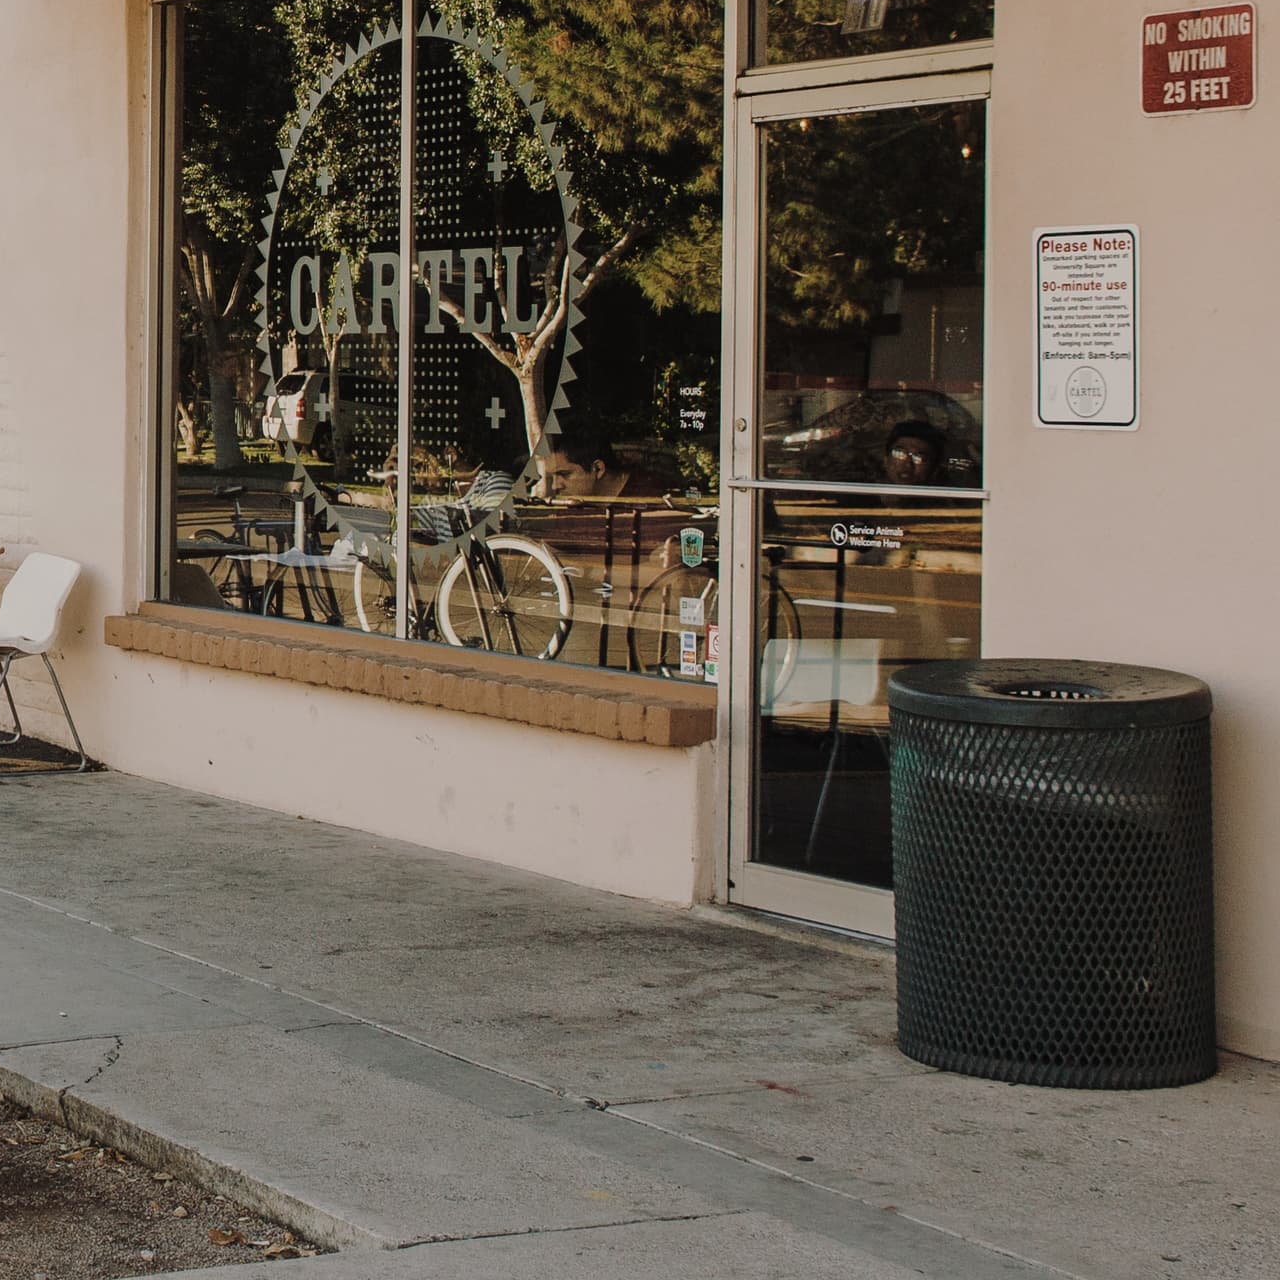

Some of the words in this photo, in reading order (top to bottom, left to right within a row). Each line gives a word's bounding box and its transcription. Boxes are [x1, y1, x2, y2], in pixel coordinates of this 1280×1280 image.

[1144, 22, 1167, 46] NO
[1178, 12, 1251, 42] SMOKING
[1168, 46, 1227, 74] WITHIN
[1163, 80, 1186, 104] 25
[1190, 76, 1232, 102] FEET
[1041, 239, 1088, 253] Please
[1093, 237, 1131, 251] Note:
[288, 246, 540, 336] CARTEL
[1042, 280, 1102, 292] 90-minute
[1106, 281, 1128, 290] use
[1042, 351, 1086, 361] (Enforced:
[679, 386, 702, 396] HOURS
[679, 408, 707, 421] Everyday
[692, 420, 705, 431] 10p
[849, 524, 875, 535] Service
[875, 526, 904, 537] Animals
[849, 536, 882, 548] Welcome
[882, 538, 901, 549] Here
